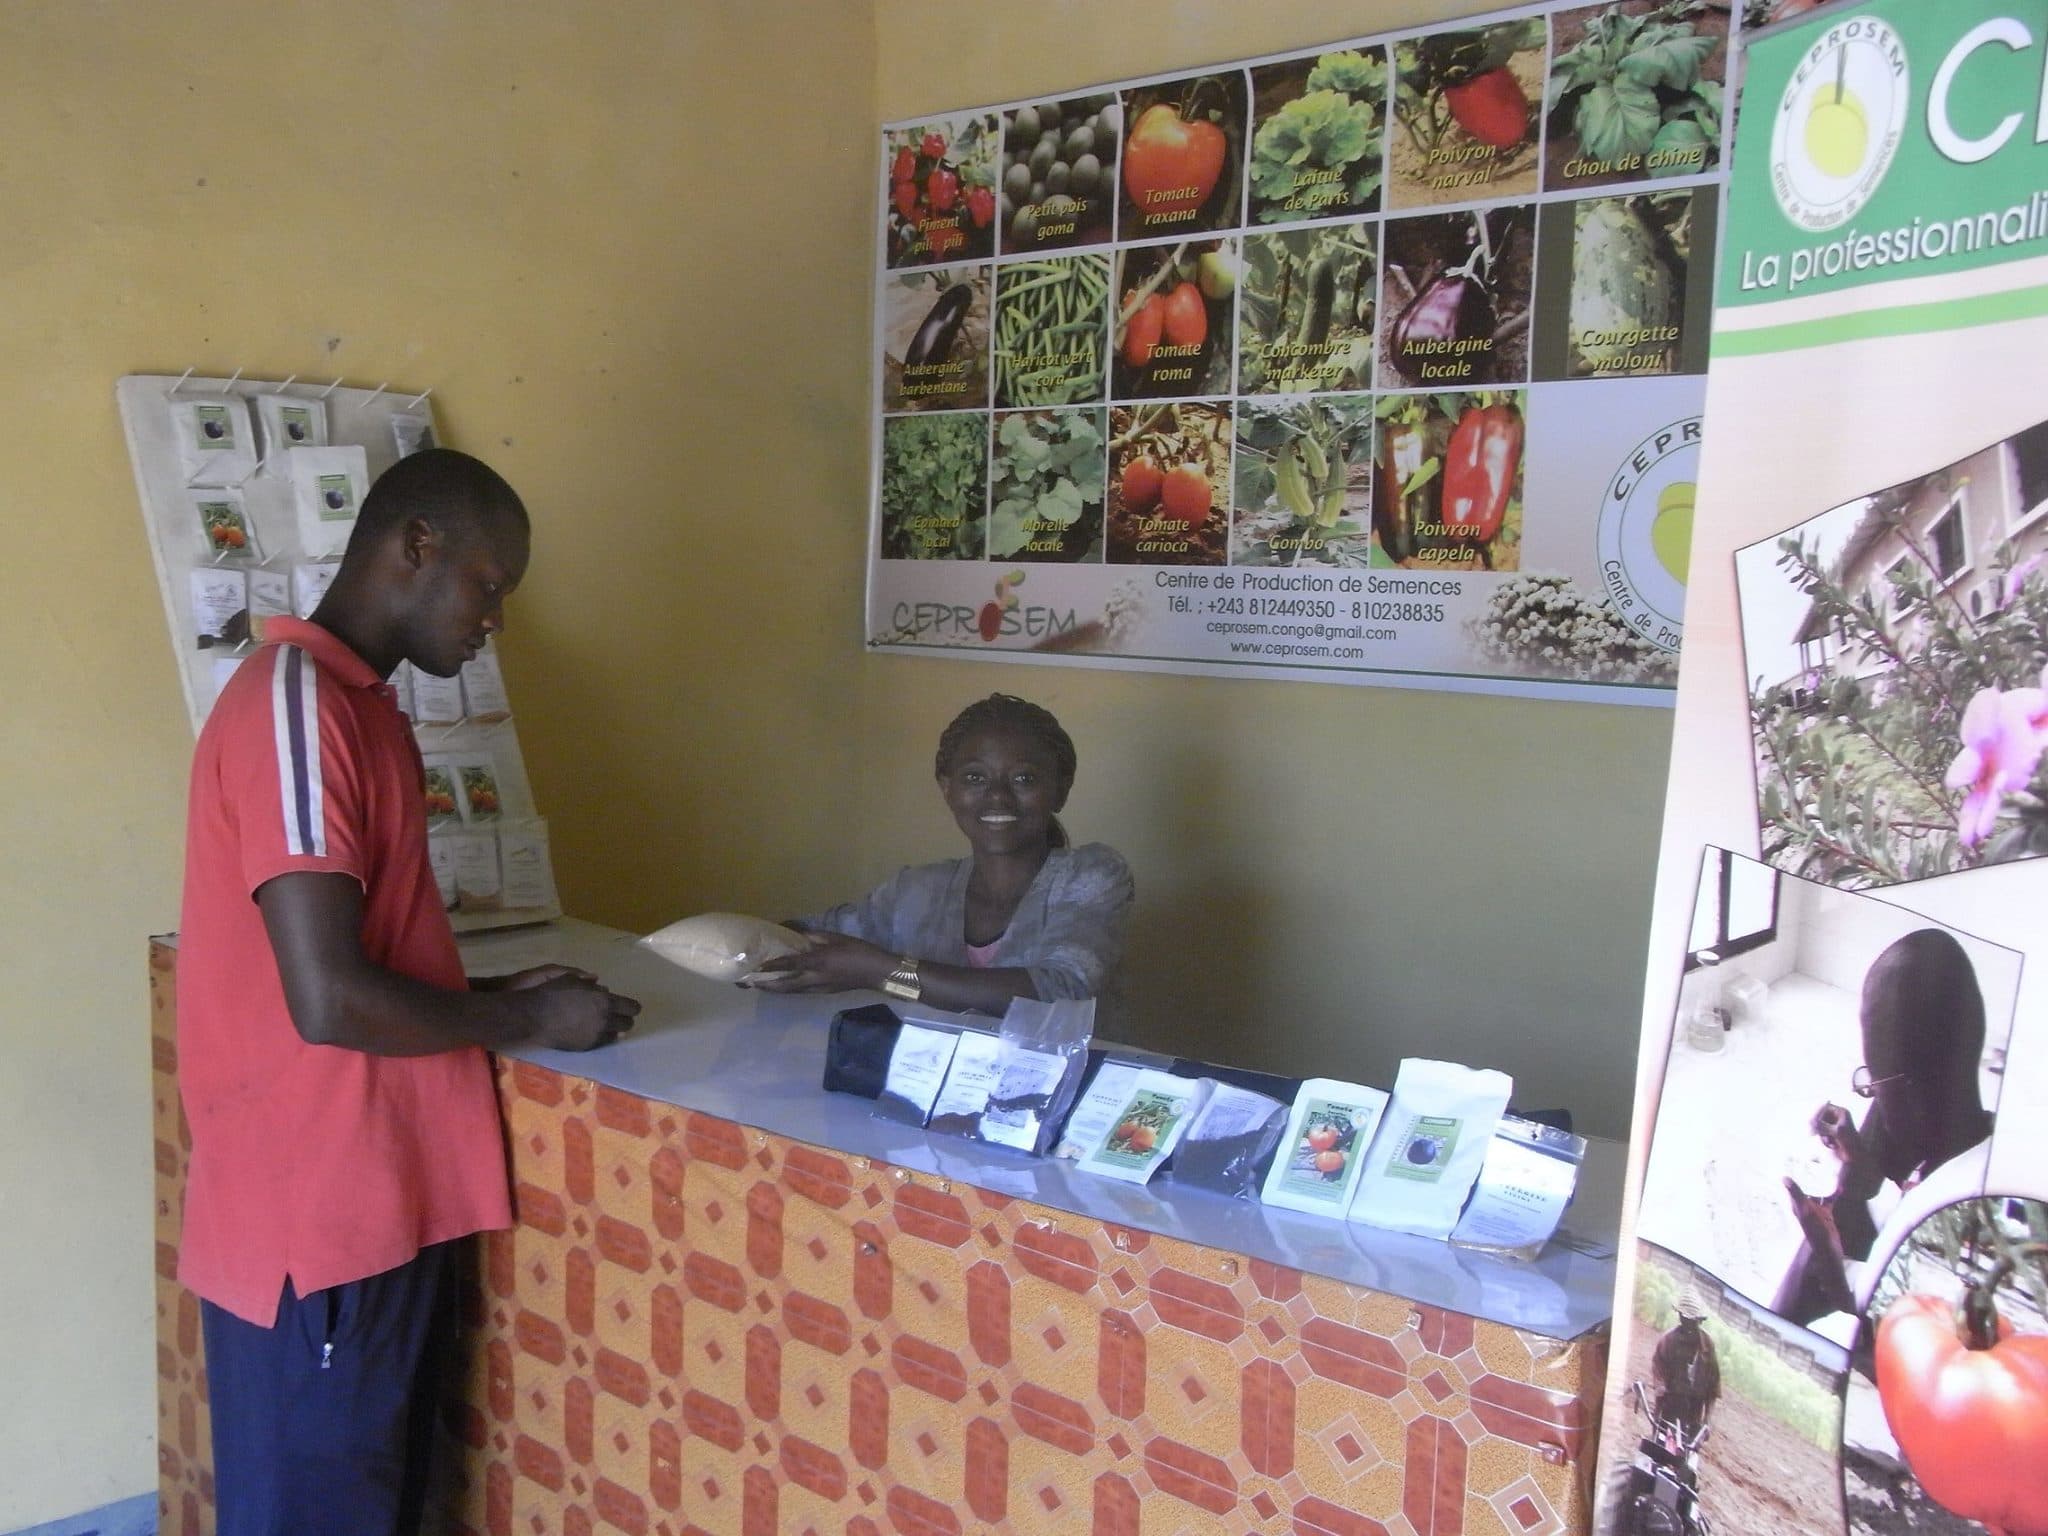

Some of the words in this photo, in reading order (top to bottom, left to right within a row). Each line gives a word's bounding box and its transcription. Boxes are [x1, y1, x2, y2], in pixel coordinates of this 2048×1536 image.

[1783, 22, 1906, 111] CEPROSEM
[1926, 17, 2048, 164] C
[1428, 144, 1497, 166] Poivron
[1563, 155, 1612, 179] Chou
[1618, 152, 1642, 172] de
[1646, 146, 1702, 169] chine
[1293, 168, 1343, 188] Laitue
[1432, 166, 1492, 189] narval
[1146, 185, 1200, 204] Tomate
[1283, 195, 1304, 212] de
[1310, 191, 1350, 208] Paris
[1026, 203, 1056, 219] Petit
[1059, 197, 1088, 217] pois
[1145, 207, 1197, 226] raxana
[919, 216, 960, 233] Piment
[1037, 222, 1075, 240] goma
[1741, 250, 1780, 290] La
[1261, 339, 1351, 359] Concombre
[1402, 335, 1493, 363] Aubergine
[1580, 325, 1679, 353] Courgette
[1012, 353, 1062, 368] Haricot
[1064, 351, 1092, 365] vert
[1146, 341, 1202, 359] Tomate
[904, 359, 965, 378] Aubergine
[1421, 360, 1472, 379] locale
[1593, 349, 1663, 372] moloni
[1152, 366, 1192, 383] roma
[899, 380, 967, 397] barbentane
[1022, 518, 1069, 533] Morelle
[1136, 517, 1190, 533] Tomate
[1414, 520, 1481, 538] Poivron
[1026, 537, 1063, 552] locale
[1136, 537, 1190, 554] carioca
[1269, 535, 1324, 551] Gombo
[1417, 544, 1476, 565] capela
[1155, 571, 1208, 589] Centre
[1213, 571, 1235, 589] de
[1243, 573, 1333, 594] Production
[1339, 574, 1361, 594] de
[1367, 575, 1462, 597] Semences
[1604, 560, 1633, 610] Centre
[1634, 612, 1652, 632] de
[1168, 596, 1191, 614] Tél.
[1207, 598, 1244, 616] +243
[1249, 598, 1335, 619] 812449350
[1351, 601, 1444, 623] 810238835
[1206, 621, 1397, 641] ceprosem.congo@gmail.com
[1230, 641, 1364, 660] www.ceprosem.com
